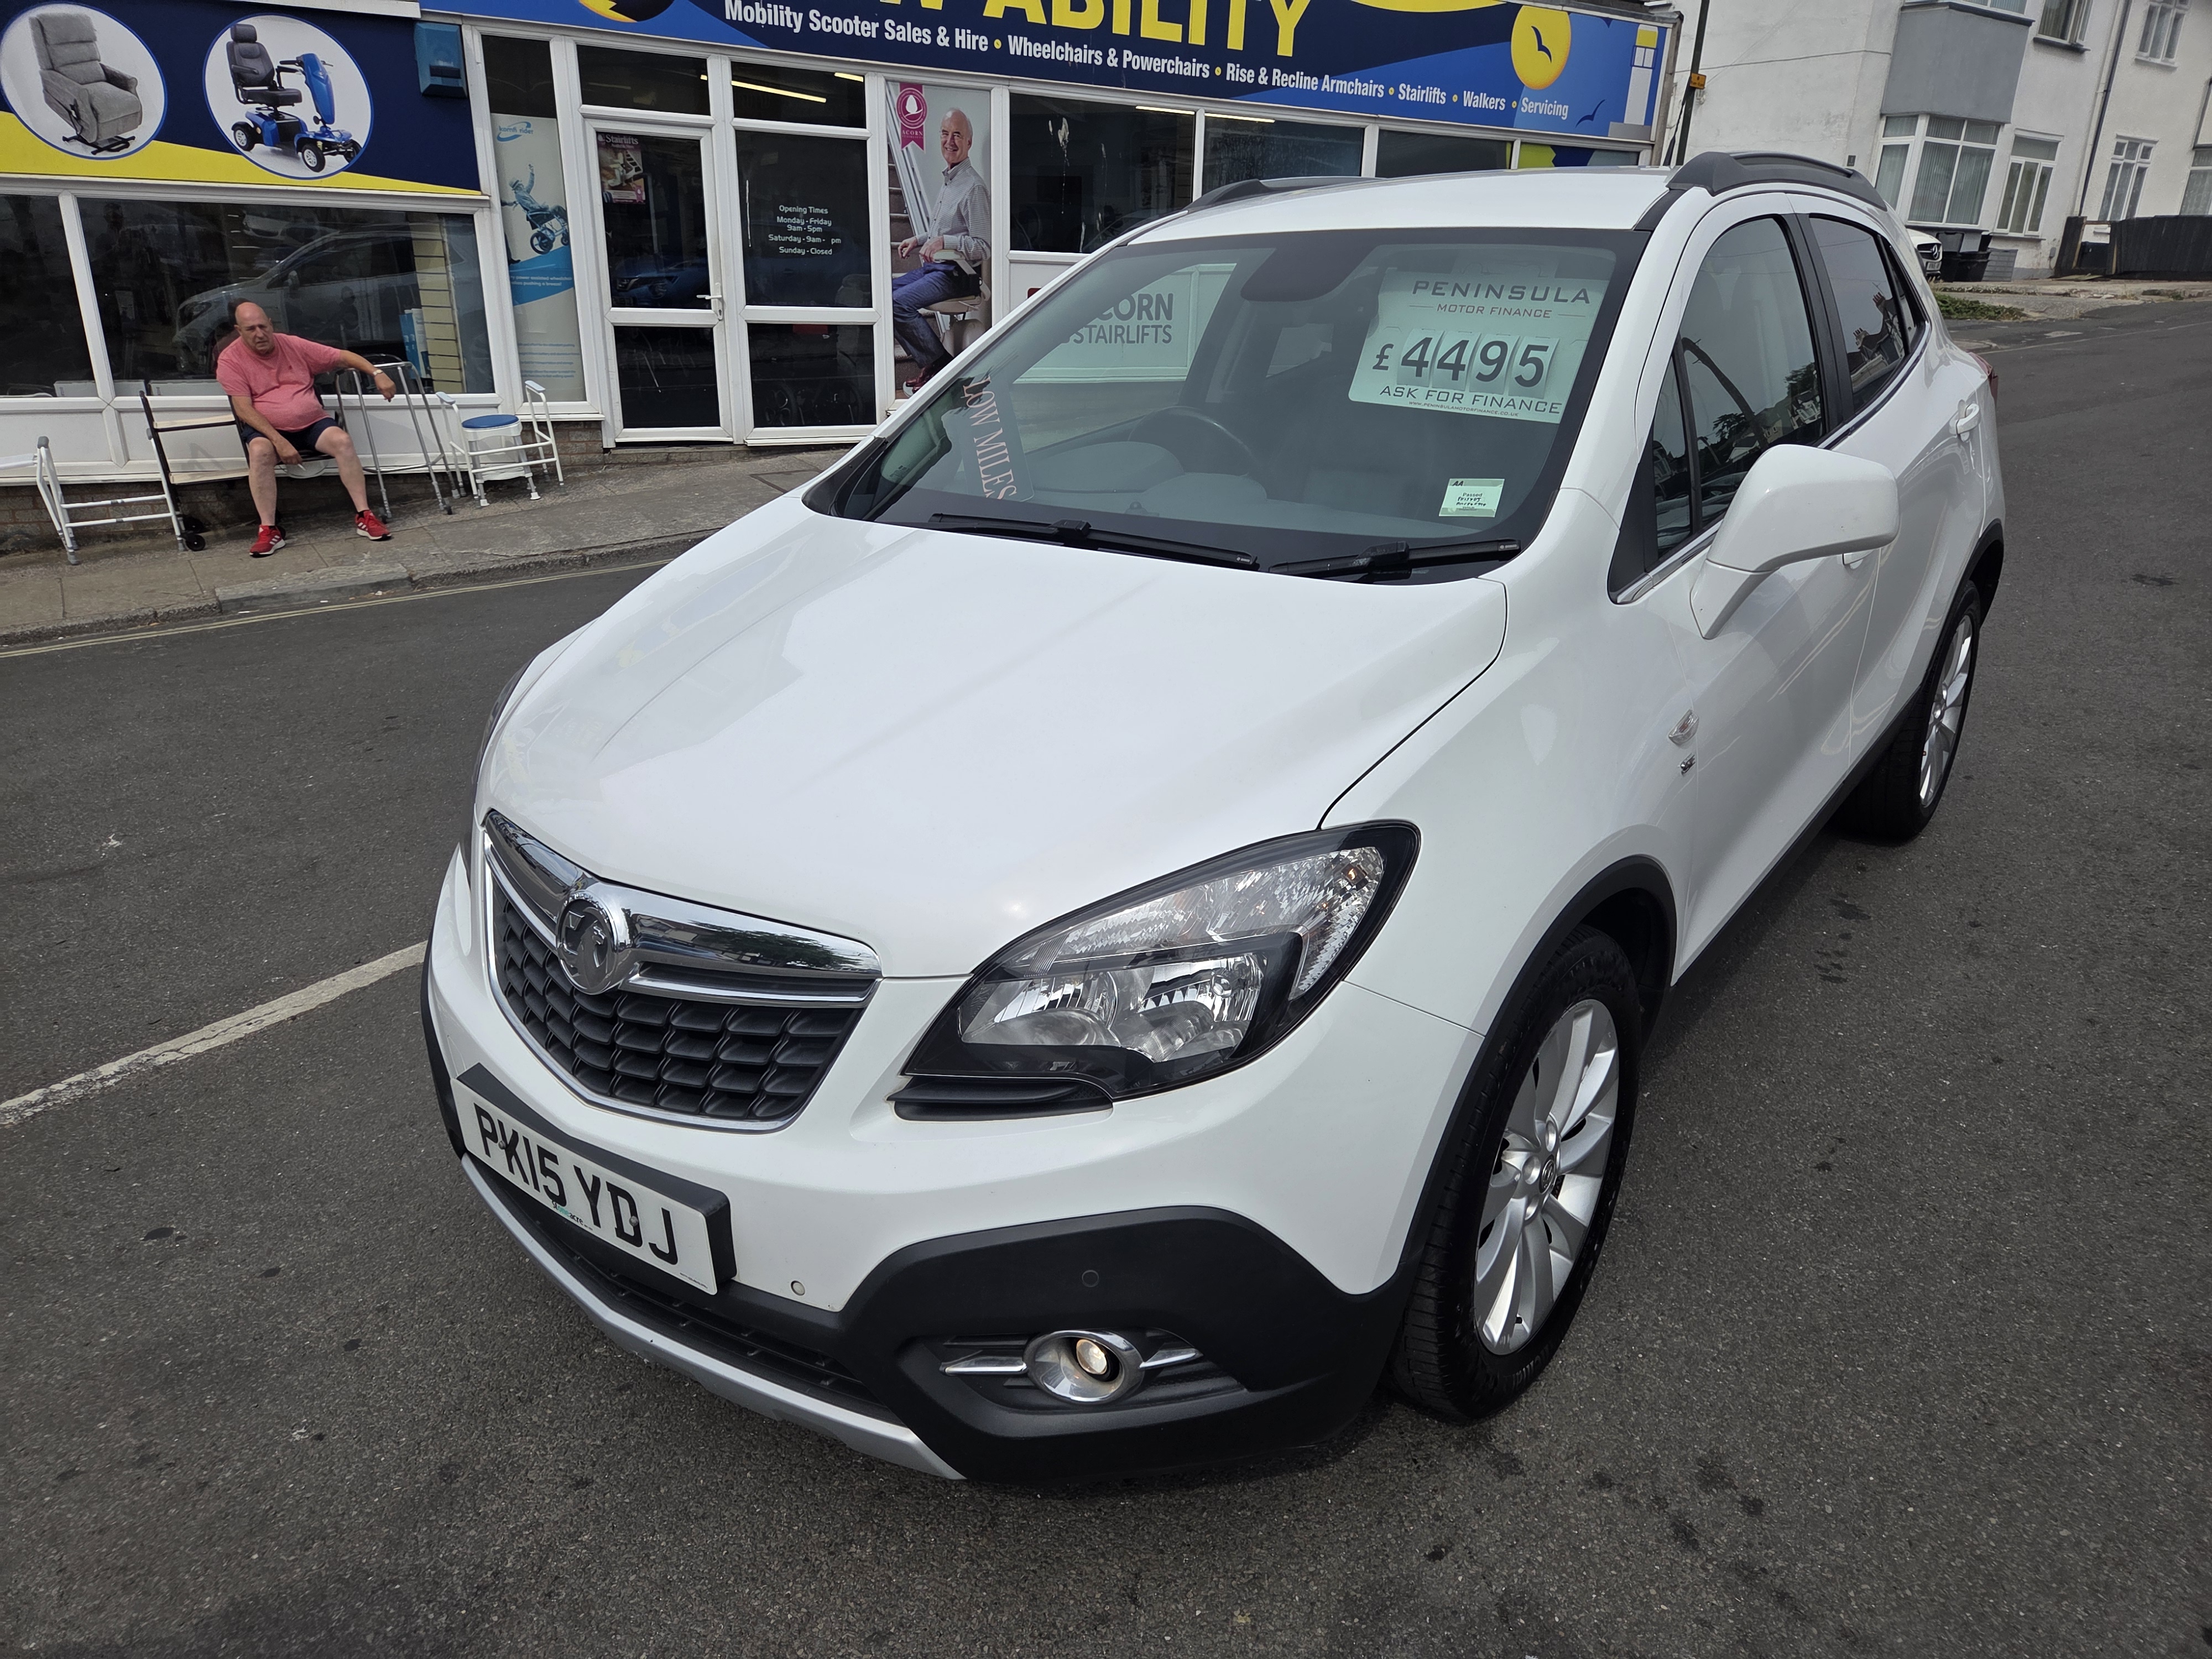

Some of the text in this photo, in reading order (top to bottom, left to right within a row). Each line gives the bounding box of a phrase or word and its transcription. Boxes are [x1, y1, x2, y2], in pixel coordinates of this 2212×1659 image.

[983, 0, 1312, 56] LITY
[725, 0, 1569, 120] Mobility Scooter Sales & Hire Wheelchairs & Powerchairs Rise & Recline Armchairs Stairlifts Walkers Servicing
[606, 134, 639, 144] Stairlifts
[779, 205, 807, 214] Opening
[776, 216, 805, 225] Monday
[810, 218, 832, 226] Friday
[768, 234, 801, 243] Saturday
[779, 247, 805, 255] Sunday
[1412, 280, 1590, 304] PENINSULA
[1437, 304, 1552, 319] MOTOR FINANCE
[1379, 385, 1562, 414] ASK FOR FINANCE
[962, 376, 1017, 499] LOW MILES
[473, 1103, 679, 1265] PK15 YDJ
